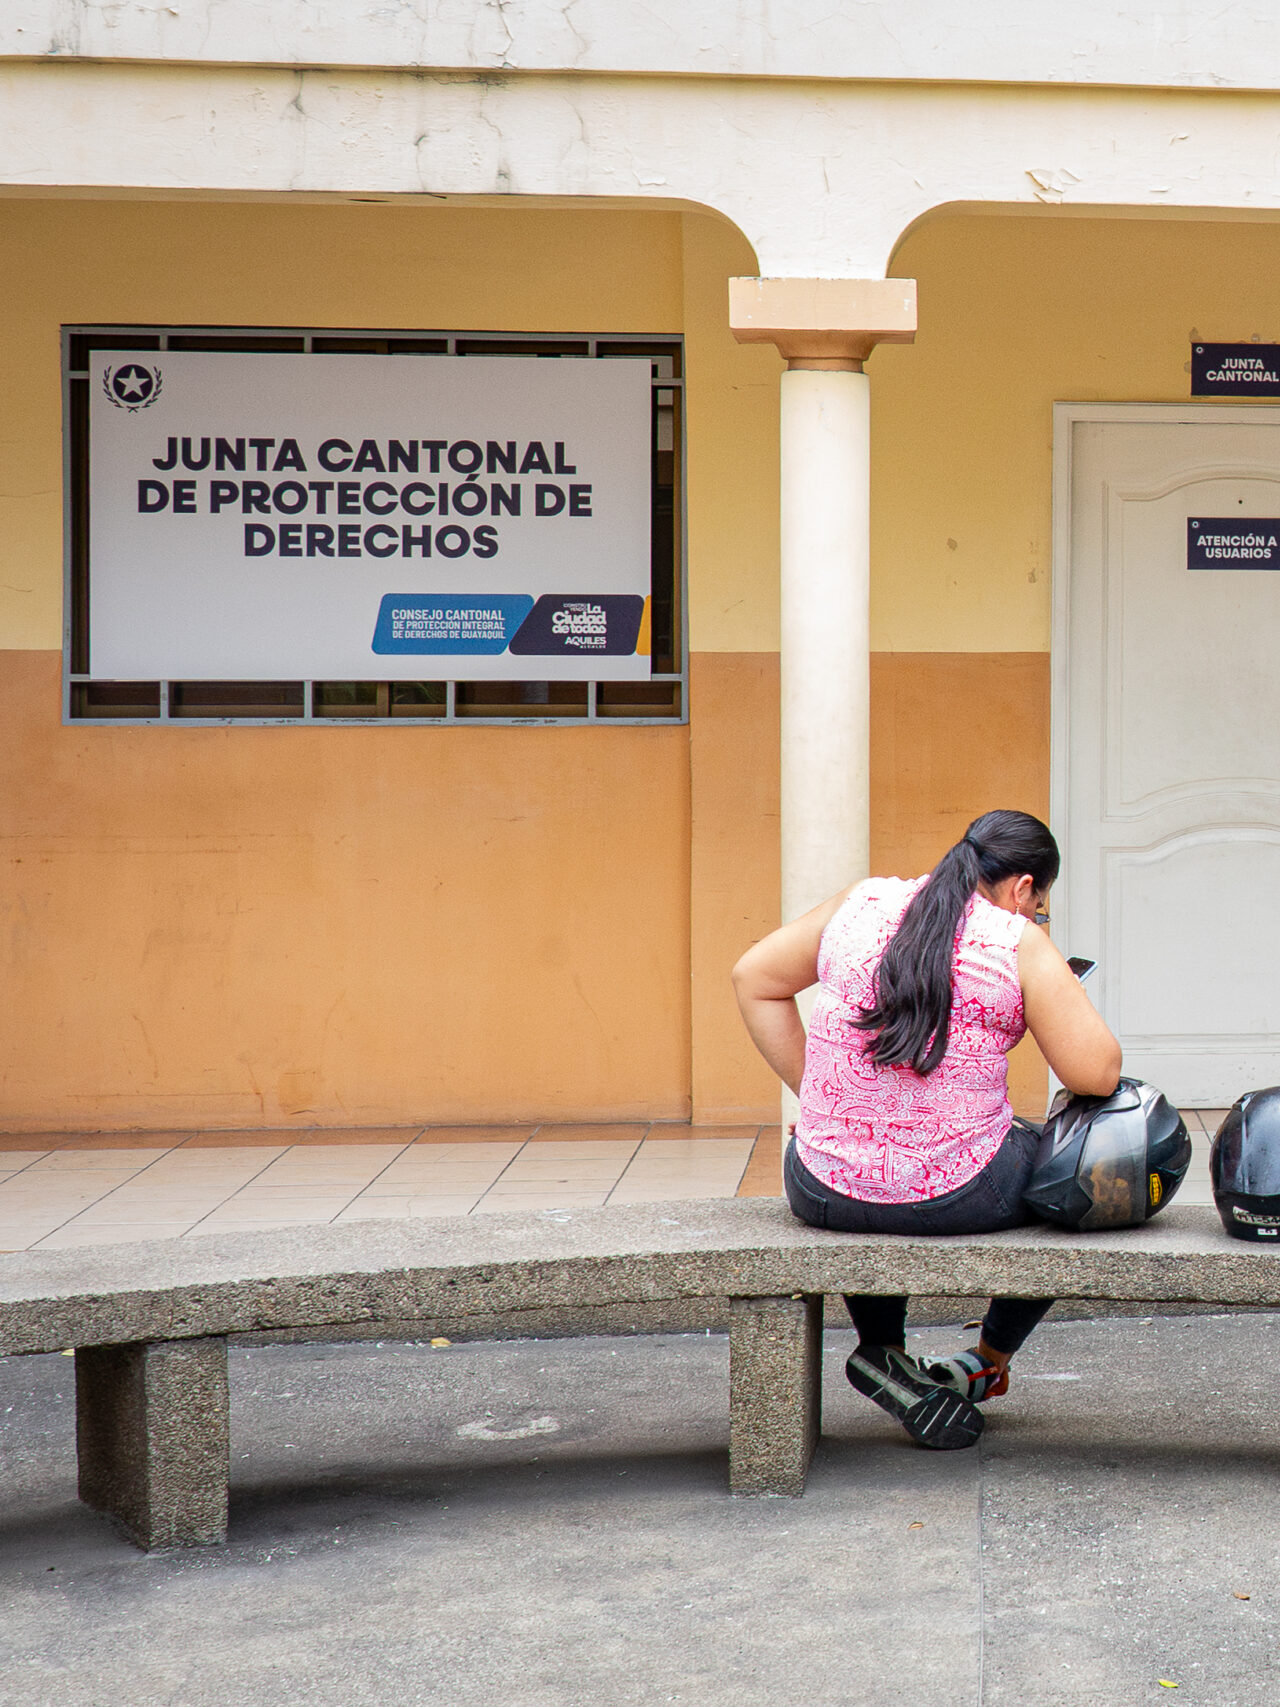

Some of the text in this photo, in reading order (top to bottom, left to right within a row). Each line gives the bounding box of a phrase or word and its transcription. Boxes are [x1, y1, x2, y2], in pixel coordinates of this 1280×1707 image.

[1221, 358, 1264, 370] JUNTA
[1206, 371, 1279, 382] CANTONAL
[152, 437, 577, 474] JUNTA CANTONAL
[138, 474, 593, 517] DE PROTECCIÓN DE
[244, 524, 499, 558] DERECHOS
[1196, 533, 1278, 547] ATENCIÓN A
[1205, 548, 1272, 559] USUARIOS
[587, 603, 602, 614] La
[391, 609, 505, 621] CONSEJO CANTONAL
[552, 610, 607, 625] Ciudad
[392, 619, 505, 630] DE PROTECCIÓN INTEGRAL
[552, 624, 570, 633] de
[392, 630, 506, 640] DE DERECHOS DE GUAYAQUIL
[564, 635, 607, 646] AQUILES
